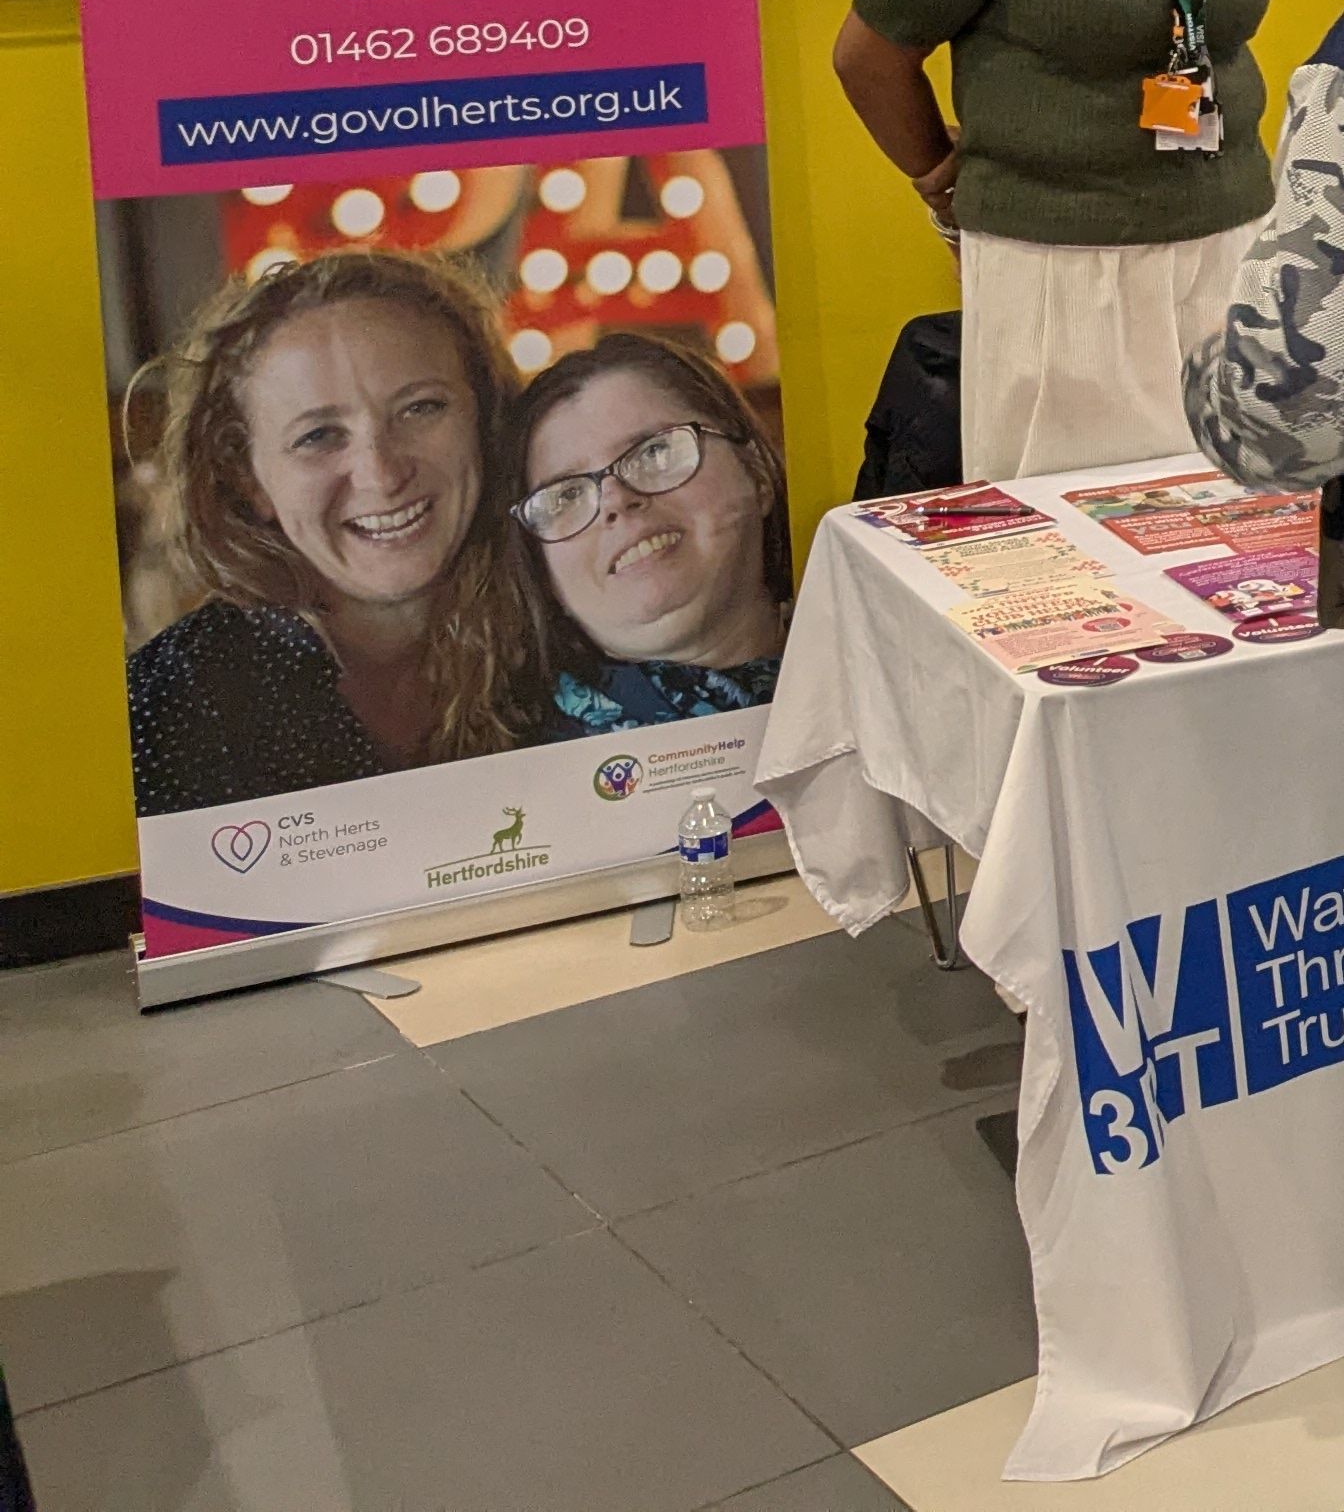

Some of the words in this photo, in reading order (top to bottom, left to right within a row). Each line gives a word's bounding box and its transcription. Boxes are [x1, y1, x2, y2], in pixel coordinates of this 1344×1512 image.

[289, 26, 417, 65] 01462
[428, 16, 590, 57] 689409
[1196, 25, 1205, 43] VISI
[178, 80, 683, 148] www.govolherts.org.uk
[1049, 665, 1130, 675] Volunteer
[648, 739, 746, 764] CommunityHelp
[648, 755, 726, 778] Hertfordshire
[278, 811, 315, 832] CVS
[279, 826, 329, 849] North
[334, 816, 381, 837] Herts
[280, 851, 292, 867] &
[297, 834, 388, 864] Stevenage
[425, 849, 550, 888] Hertfordshire
